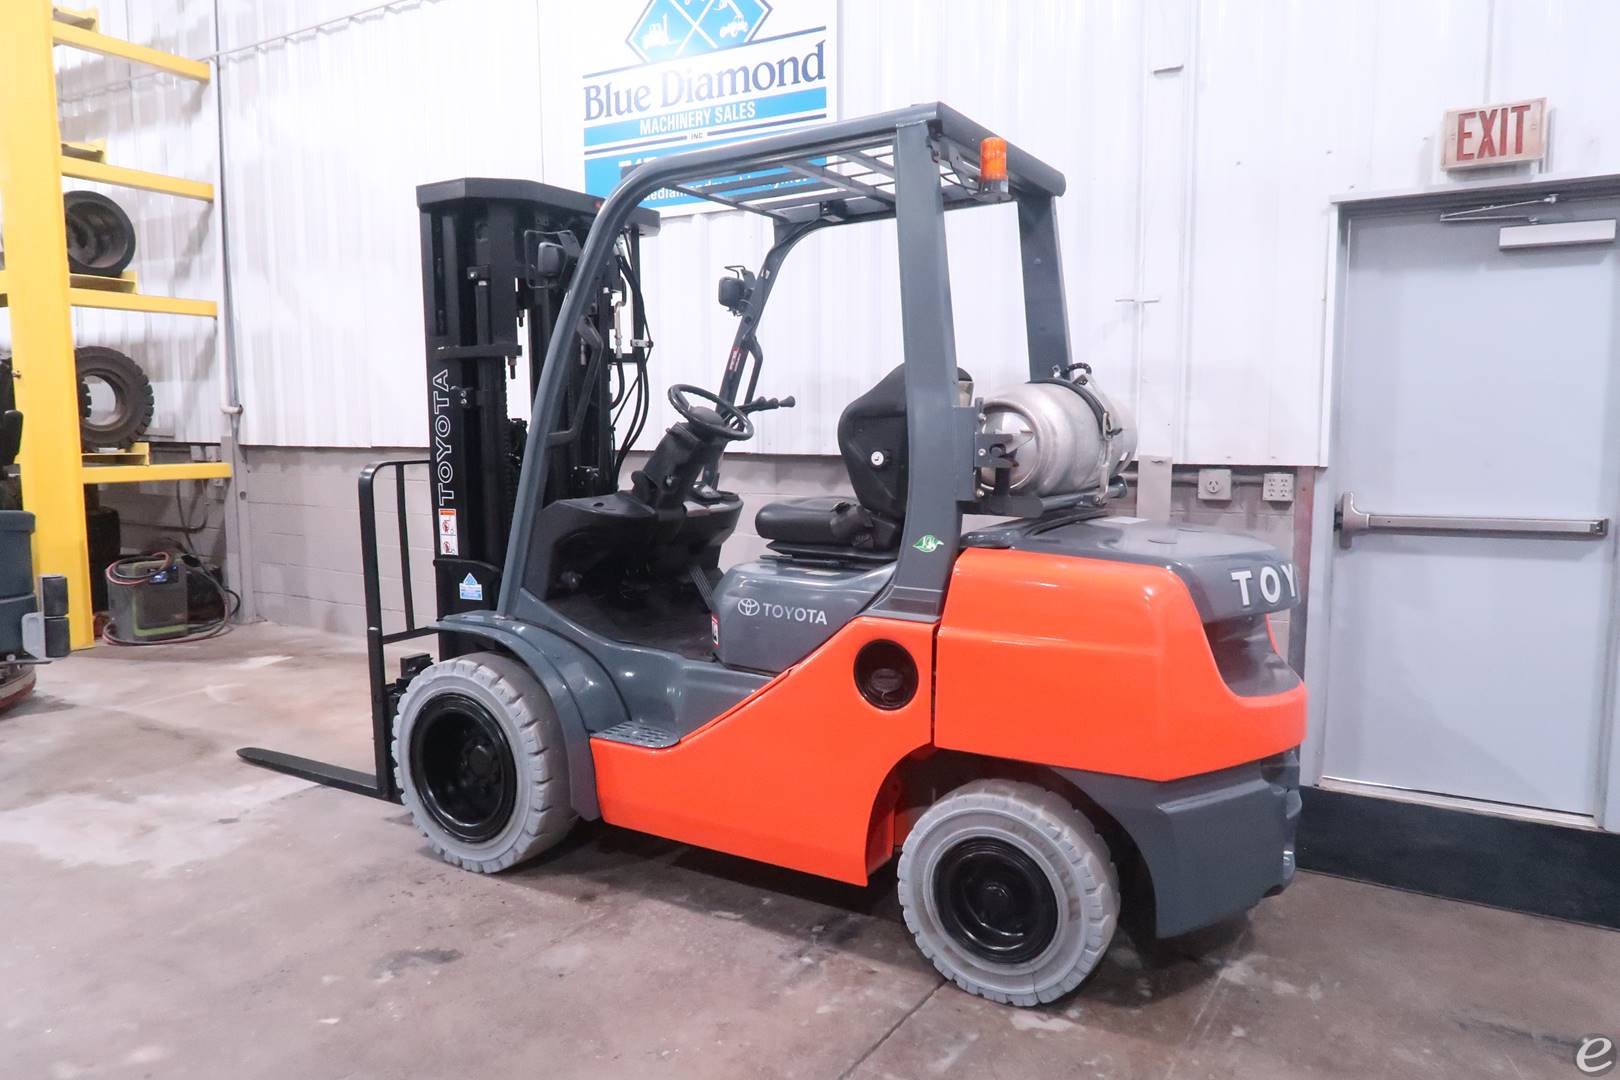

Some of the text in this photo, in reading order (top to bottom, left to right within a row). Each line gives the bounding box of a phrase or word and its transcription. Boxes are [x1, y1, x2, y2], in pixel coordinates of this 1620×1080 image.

[584, 40, 826, 121] Blue Diamond
[640, 101, 756, 137] MACHINERY SALES
[690, 131, 704, 141] INC
[1457, 105, 1531, 161] EXIT
[433, 369, 454, 506] TOYOTA
[1231, 563, 1296, 606] TOY
[763, 603, 828, 625] TOYOTA
